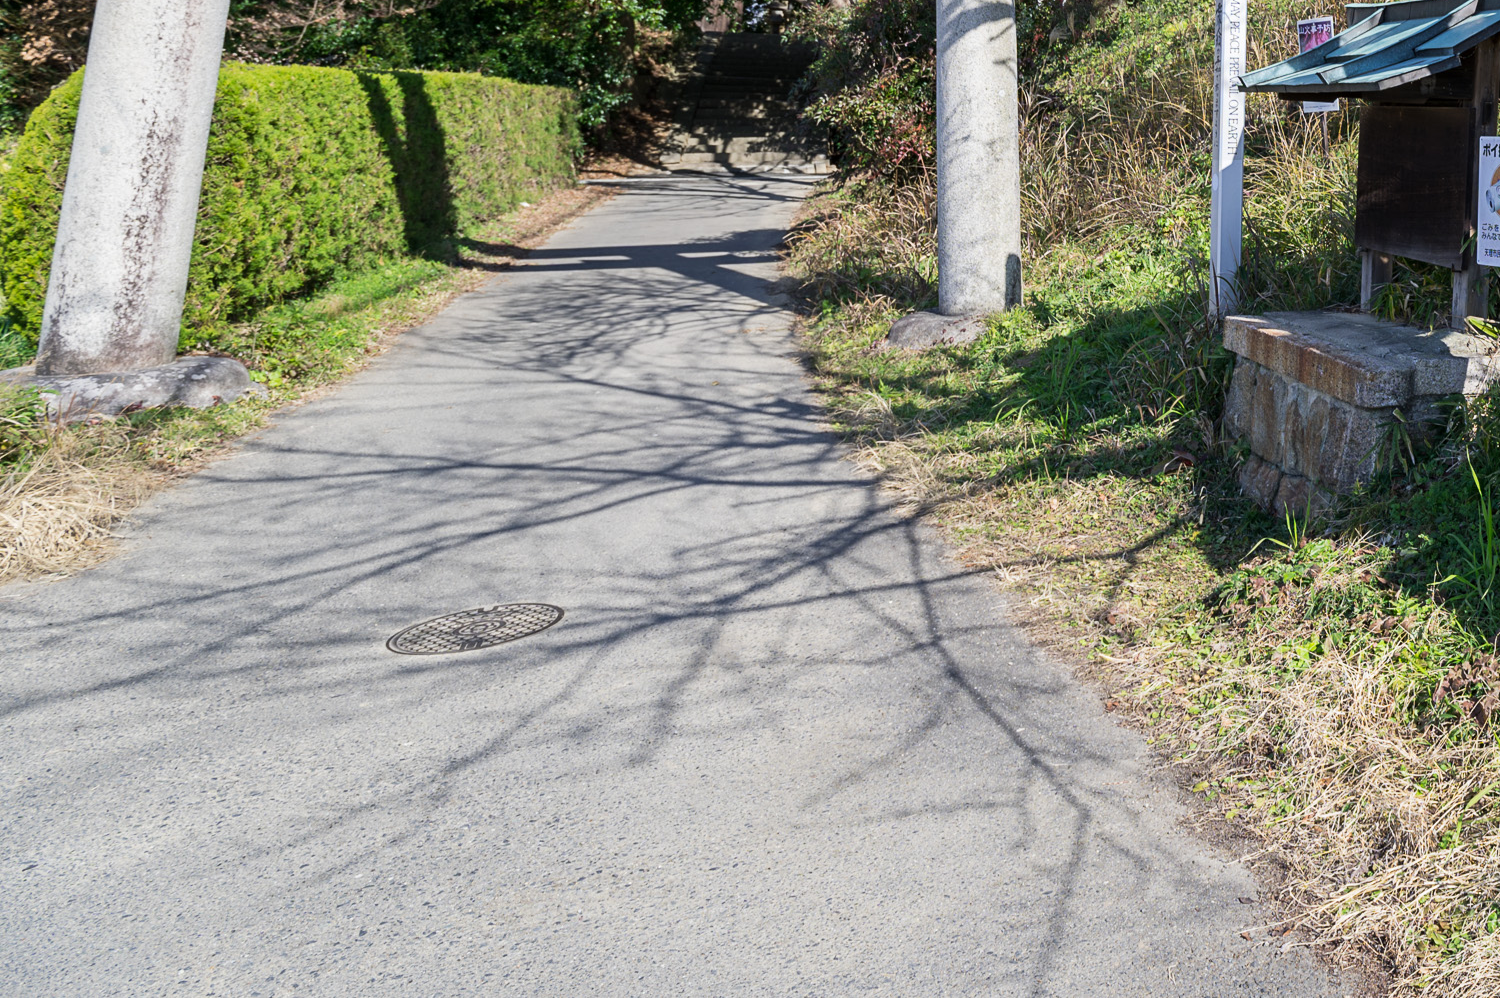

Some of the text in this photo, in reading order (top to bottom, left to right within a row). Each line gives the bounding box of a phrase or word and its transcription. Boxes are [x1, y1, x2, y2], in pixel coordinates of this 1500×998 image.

[1230, 21, 1240, 54] PEACE
[1300, 23, 1331, 35] 山火事予防
[1228, 57, 1240, 98] PREVAIL
[1228, 99, 1239, 116] ON
[1227, 118, 1239, 155] EARTH
